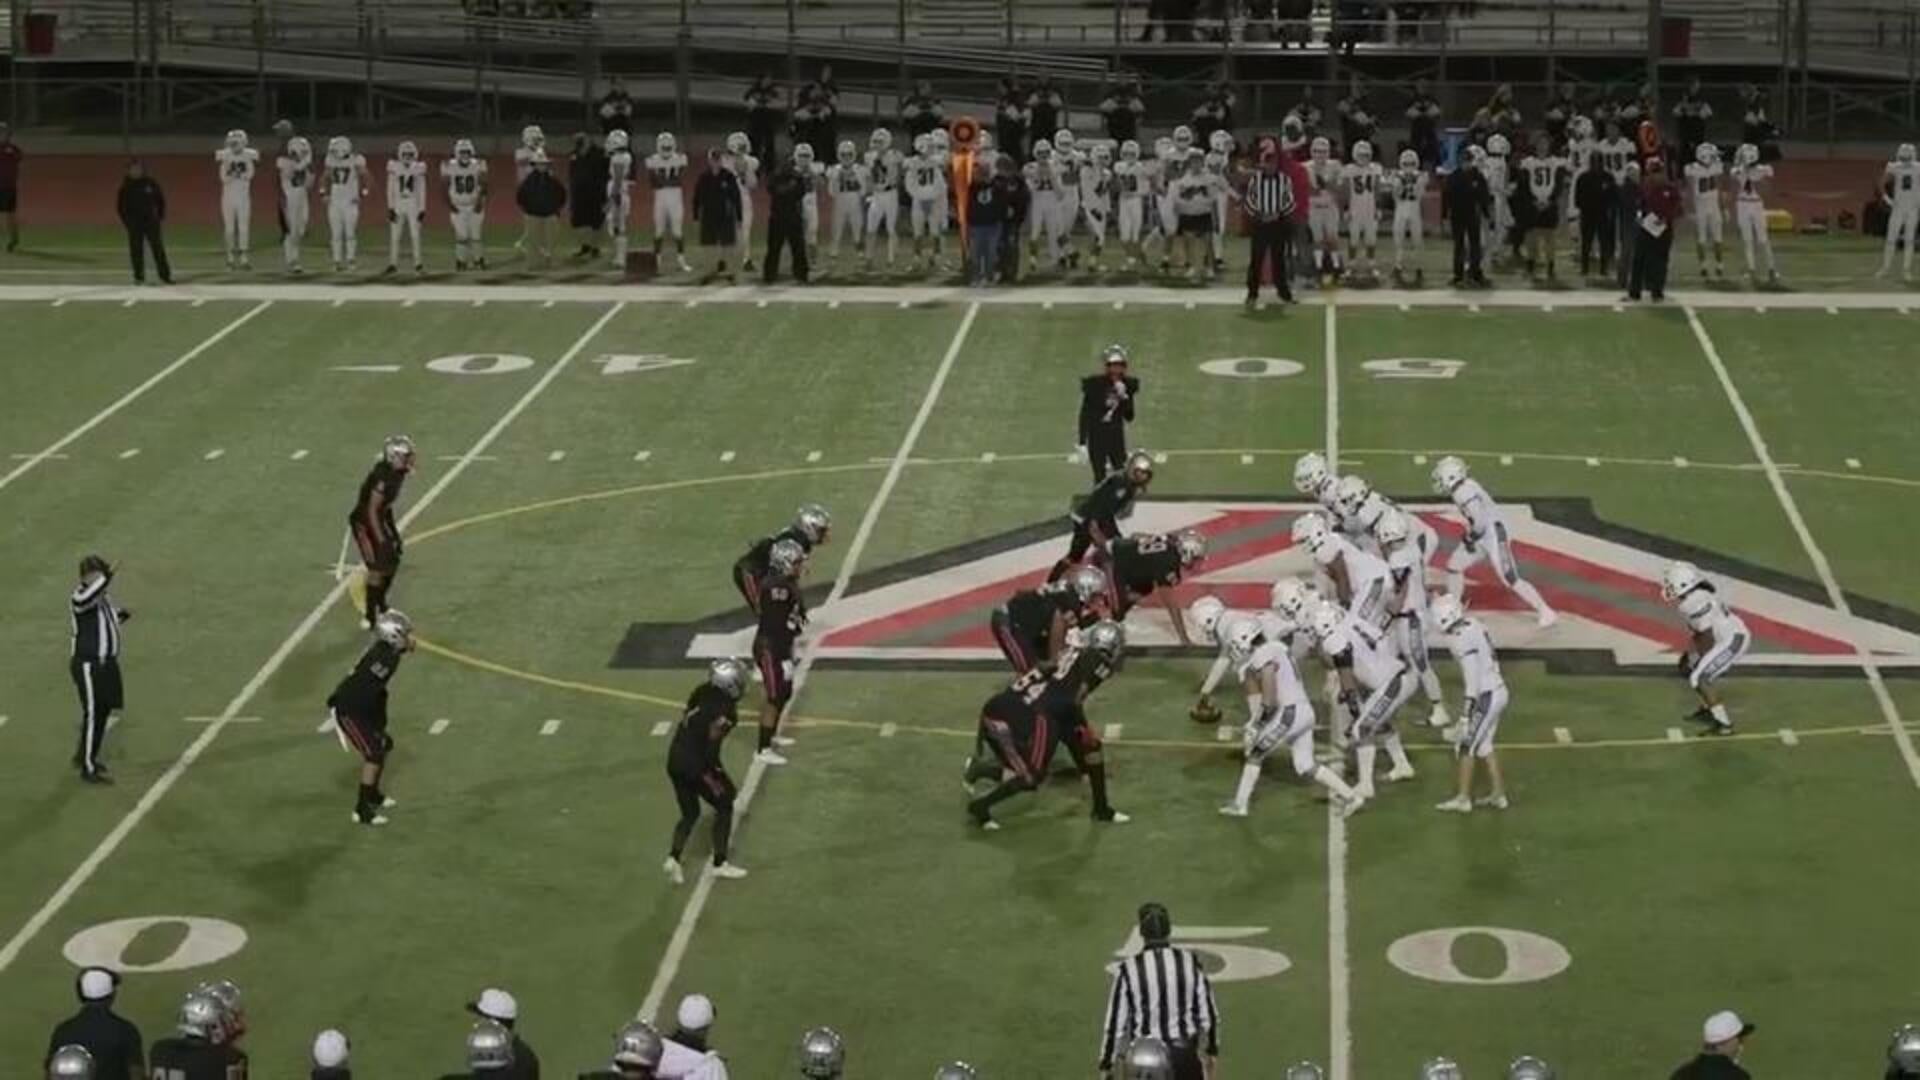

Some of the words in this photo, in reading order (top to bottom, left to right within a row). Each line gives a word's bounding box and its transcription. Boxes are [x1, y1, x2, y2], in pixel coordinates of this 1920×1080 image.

[399, 174, 414, 192] 14
[918, 167, 934, 186] 31
[1353, 174, 1373, 194] 54
